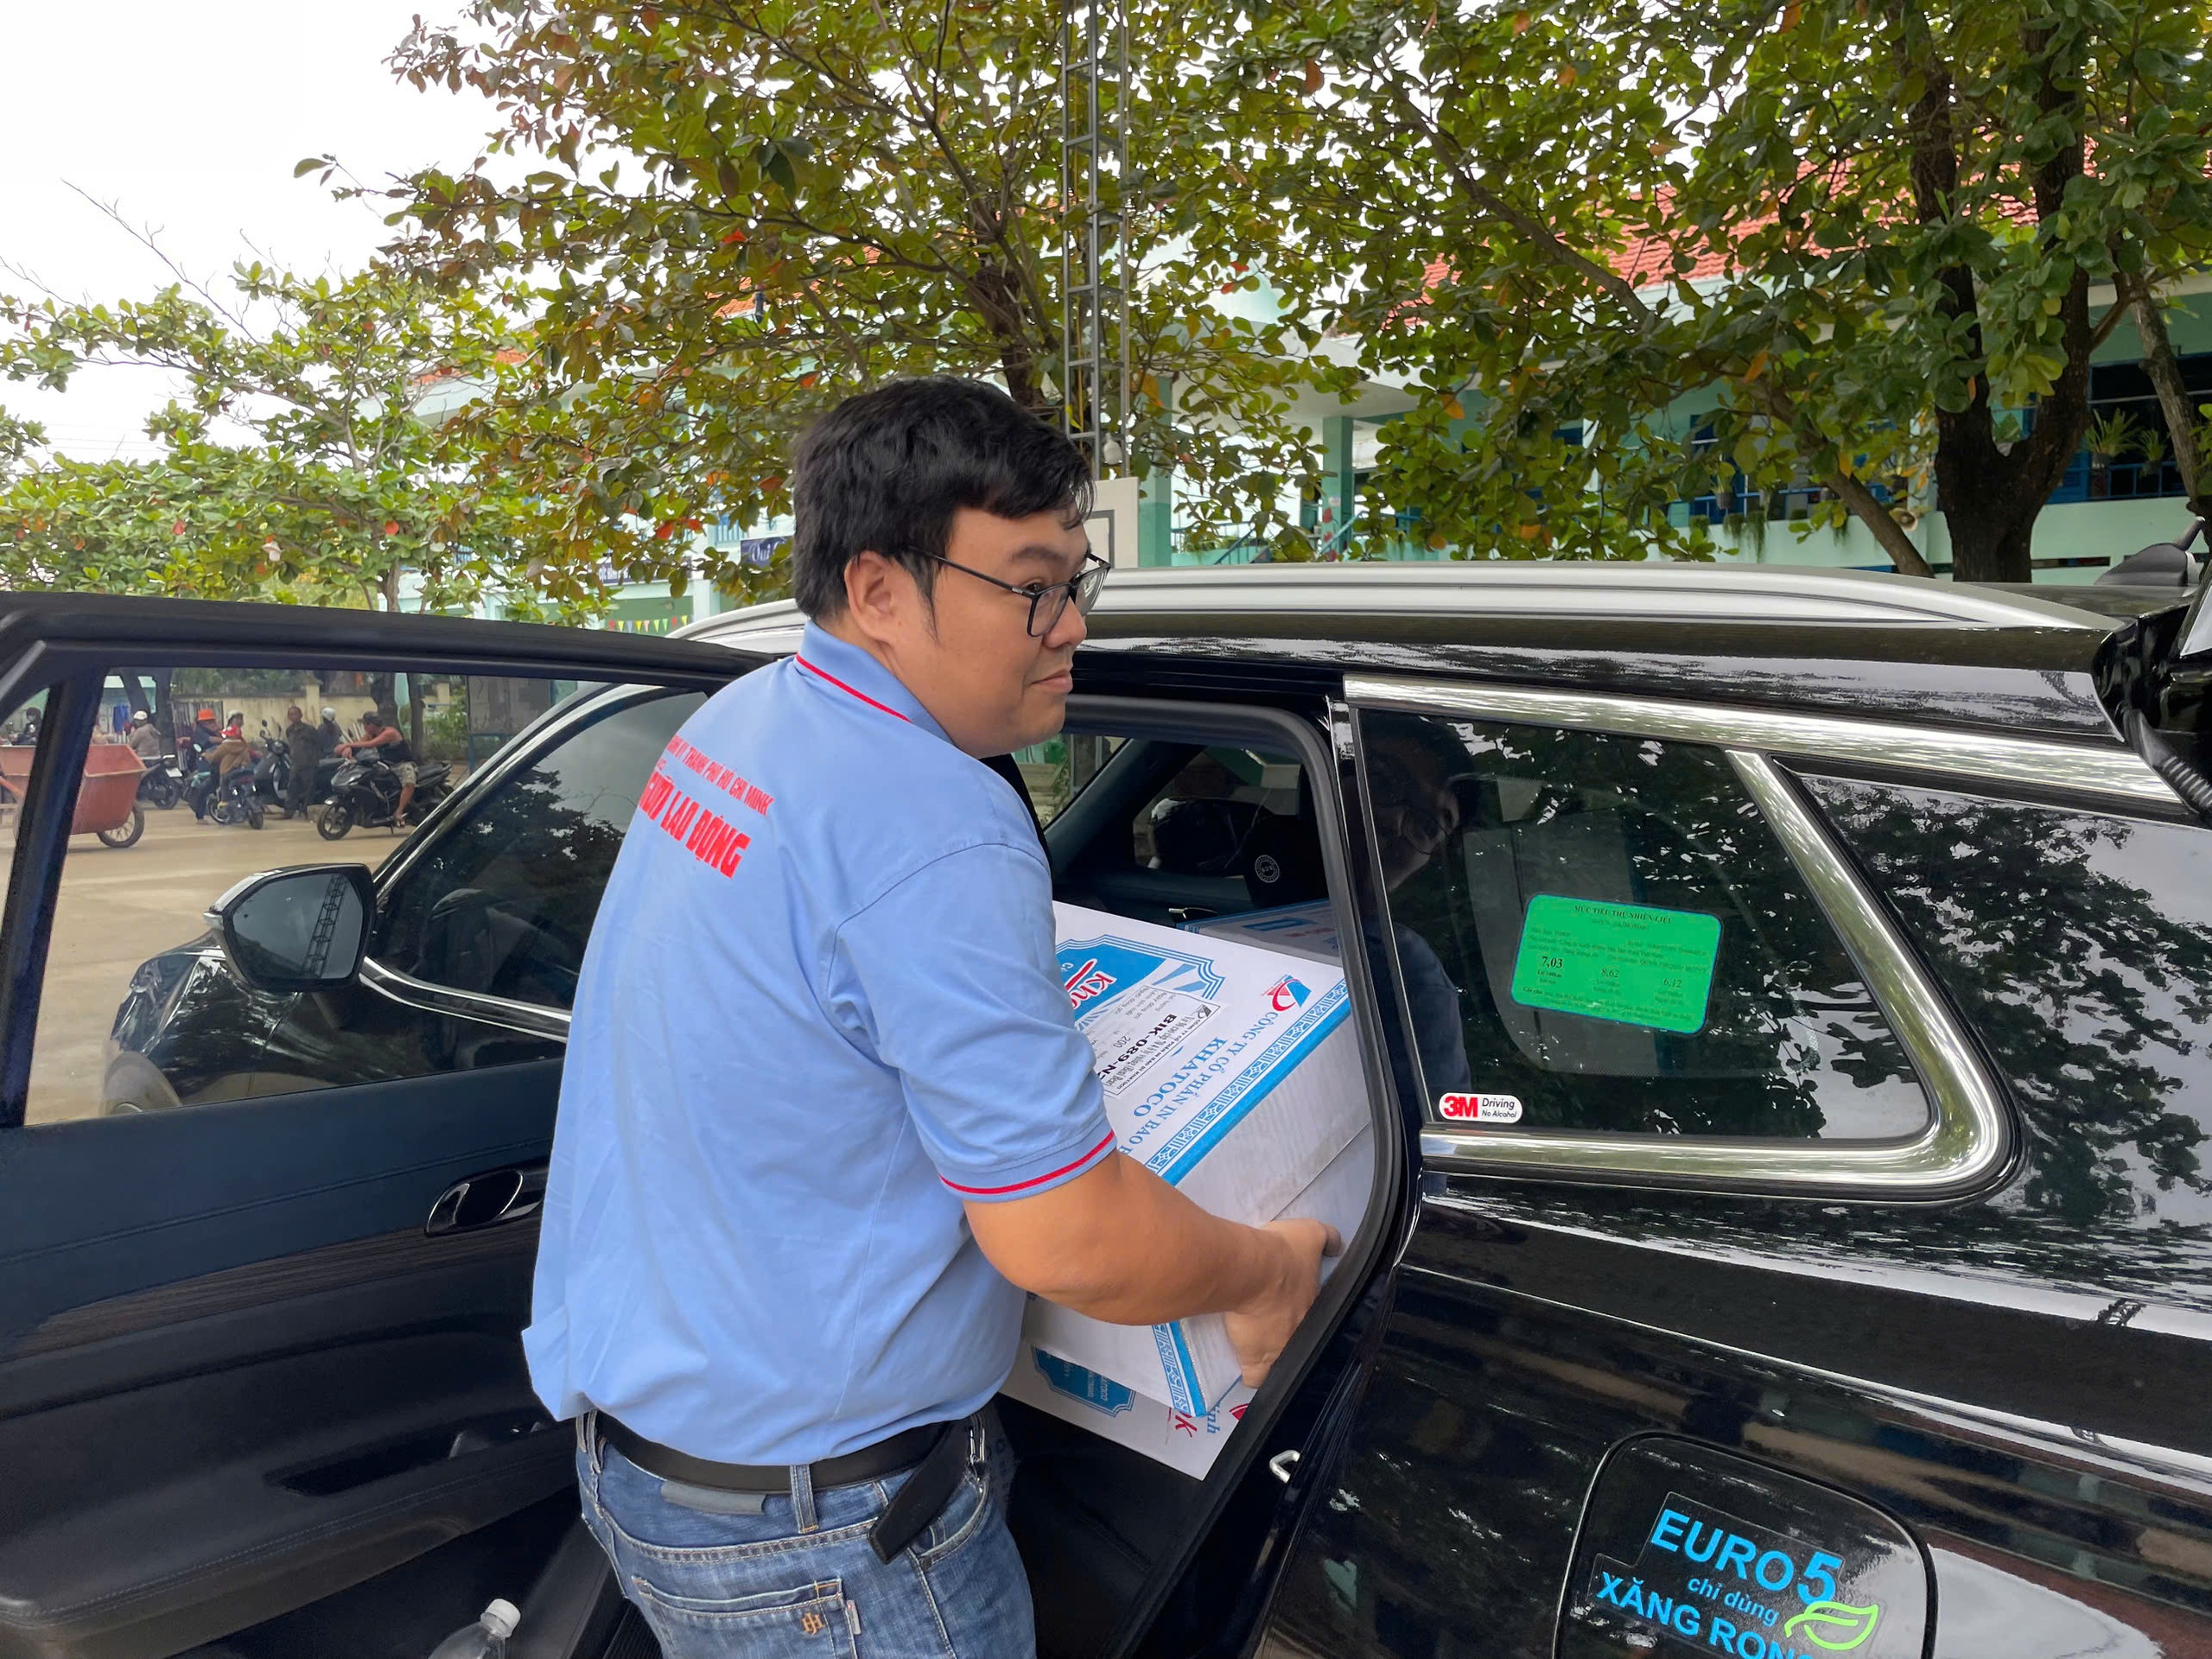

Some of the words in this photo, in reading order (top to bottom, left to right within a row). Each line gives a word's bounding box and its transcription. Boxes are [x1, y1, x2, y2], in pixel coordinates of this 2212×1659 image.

[660, 790, 701, 842] LAO
[1541, 956, 1564, 969] 7,03
[1601, 968, 1620, 978] 8,62
[1663, 978, 1682, 989] 6,12
[1243, 1011, 1279, 1040] CÔNG
[1226, 1041, 1248, 1057] TY
[1134, 1037, 1228, 1117] KHATOCO
[1208, 1056, 1230, 1074] CỔ
[1172, 1072, 1212, 1104] PHẦN
[1156, 1105, 1178, 1120] IN
[1444, 1096, 1478, 1118] 3M
[1482, 1097, 1515, 1110] Driving
[1128, 1119, 1161, 1145] BAO
[1650, 1508, 1795, 1592] EURO
[1796, 1551, 1843, 1605] 5
[1688, 1576, 1723, 1601] chỉ
[1724, 1591, 1780, 1627] dùng
[1597, 1571, 1701, 1637] XĂNG
[1709, 1617, 1814, 1659] RON
